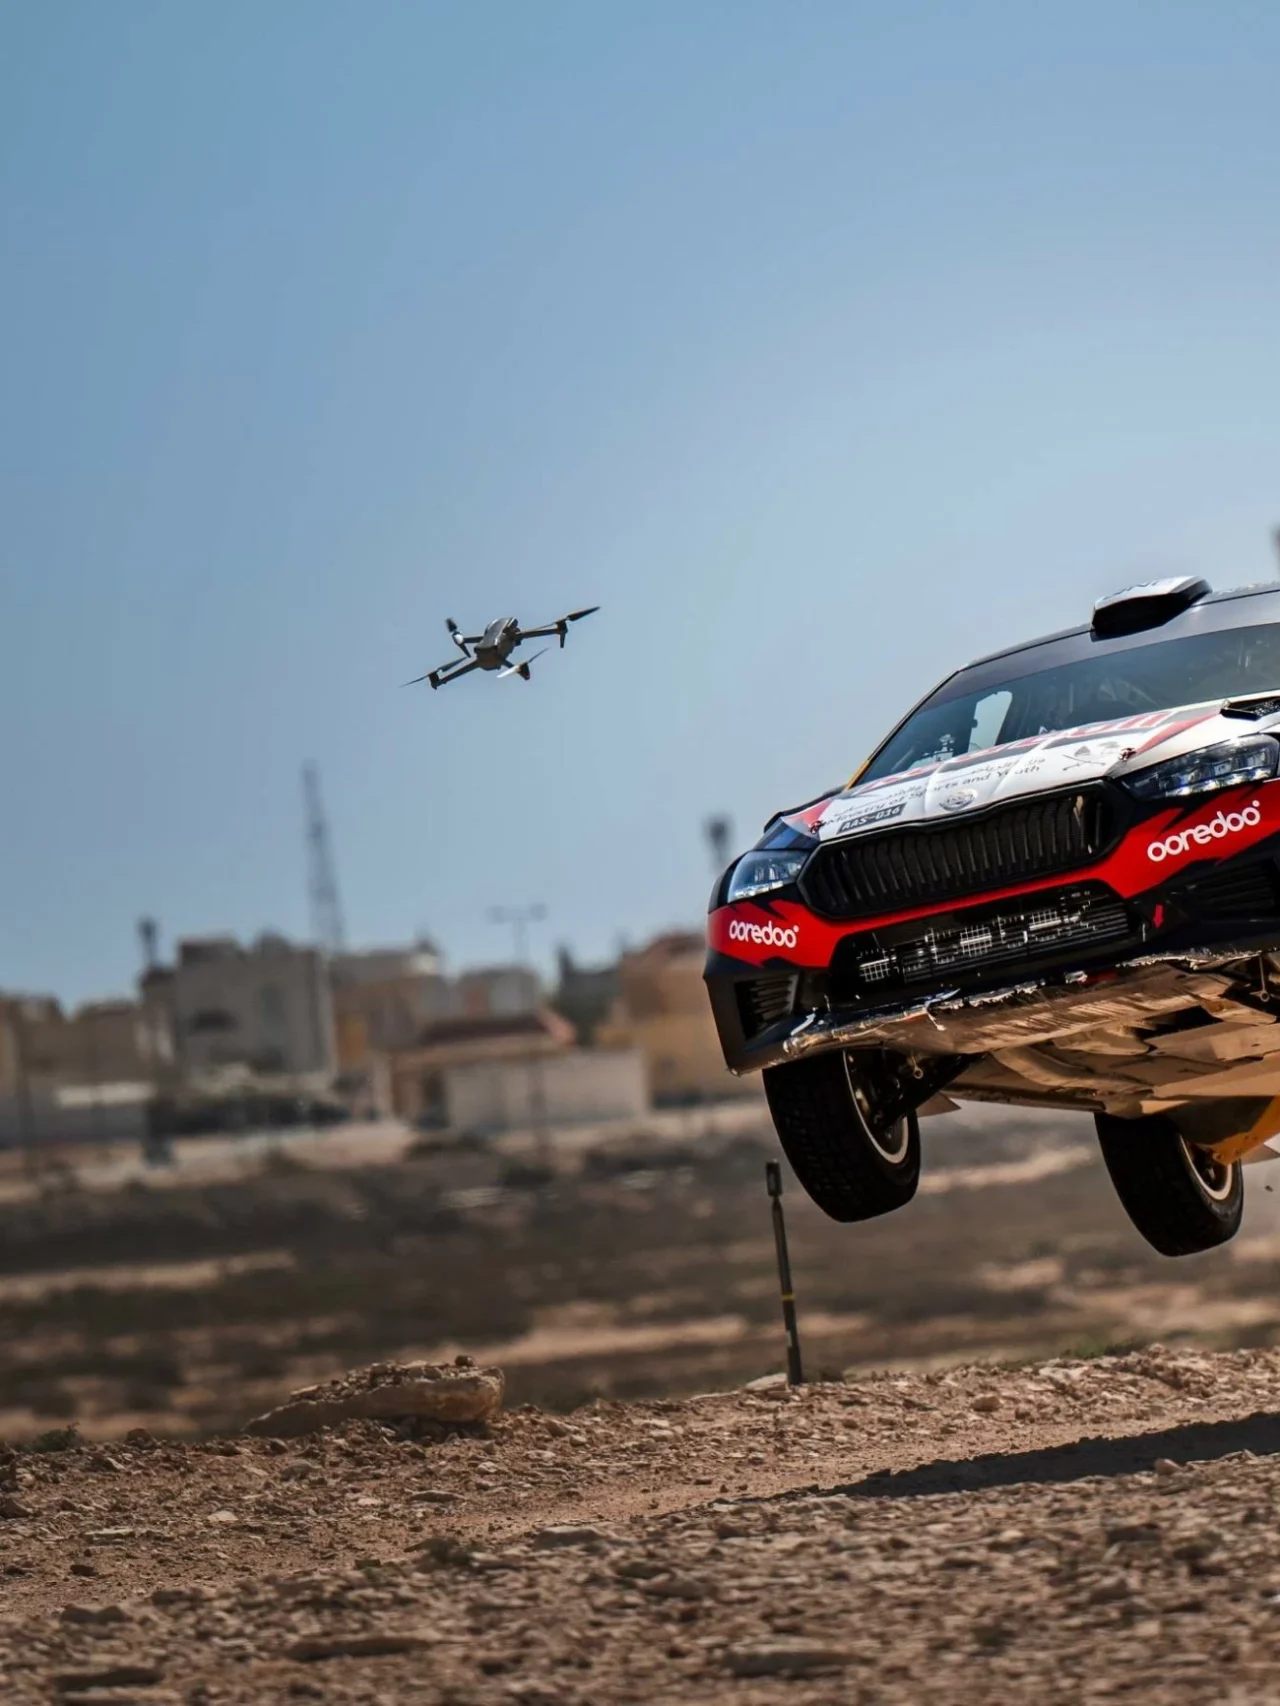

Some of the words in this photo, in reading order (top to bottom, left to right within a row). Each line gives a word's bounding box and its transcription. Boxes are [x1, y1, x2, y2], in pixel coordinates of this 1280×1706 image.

[908, 780, 958, 800] Sprts
[962, 773, 991, 786] and
[841, 806, 901, 831] AAS-036
[1147, 800, 1260, 862] ooredoo
[729, 919, 799, 948] ooredoo
